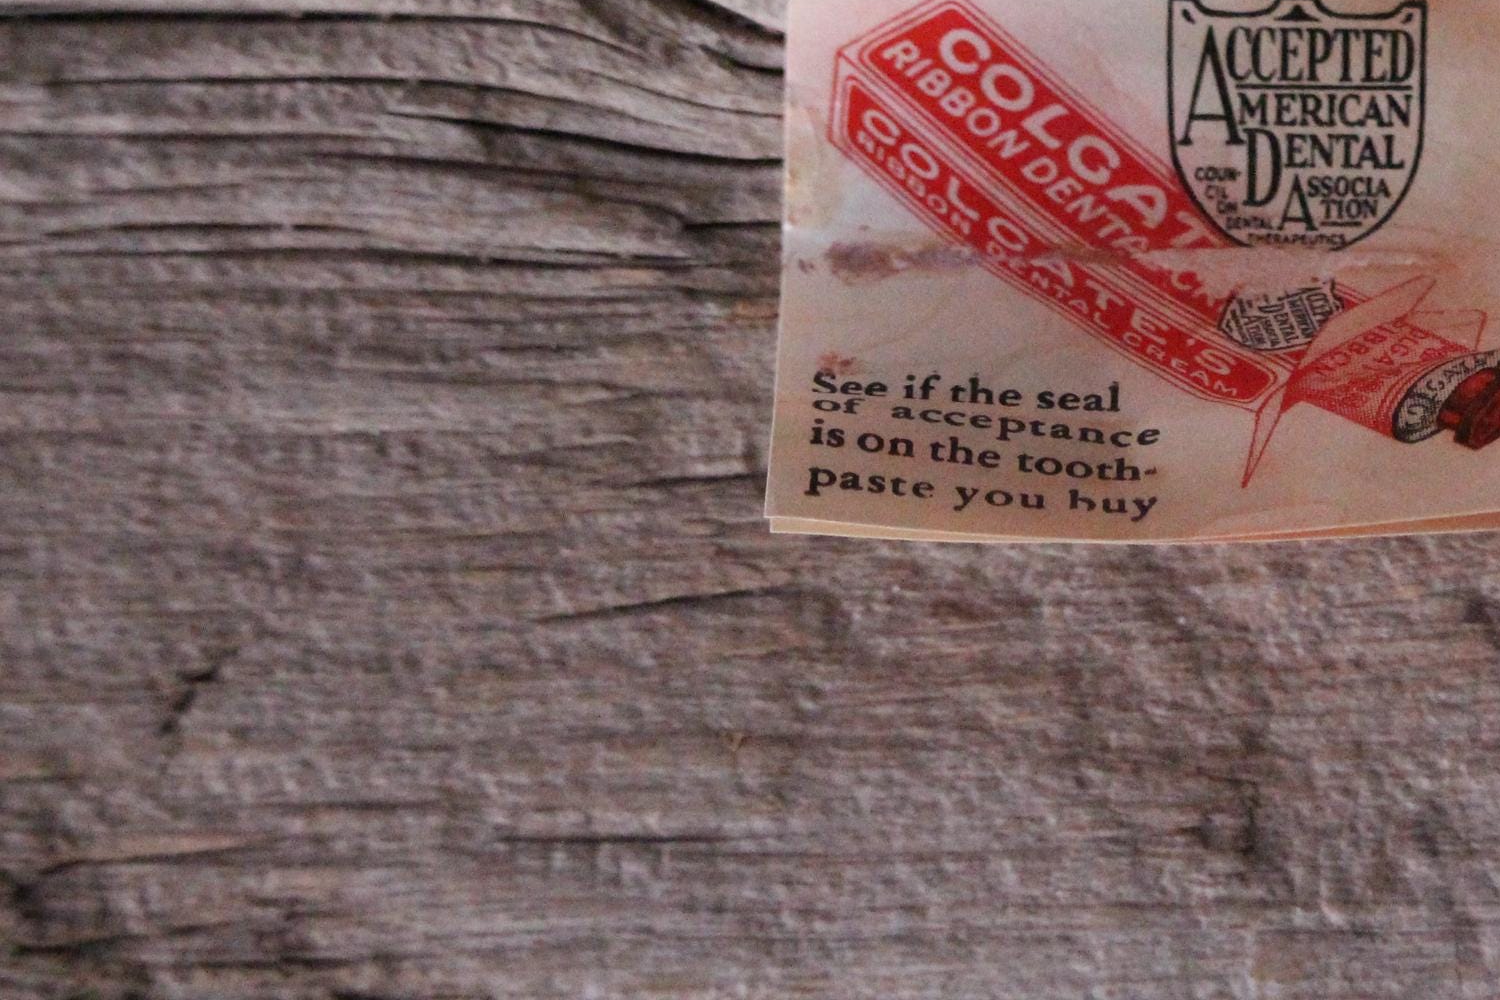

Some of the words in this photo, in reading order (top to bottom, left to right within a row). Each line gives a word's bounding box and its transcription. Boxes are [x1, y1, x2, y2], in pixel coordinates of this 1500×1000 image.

[882, 40, 1030, 159] RIBBON
[1243, 128, 1405, 206] DENTAL
[1122, 331, 1237, 396] CREAM
[812, 369, 888, 398] See
[903, 374, 941, 400] if
[949, 374, 1022, 408] the
[1036, 381, 1121, 412] seal
[809, 418, 845, 449] is
[857, 431, 915, 459] on
[929, 436, 1001, 469] the
[811, 398, 867, 415] of
[891, 404, 1161, 449] acceptance
[803, 466, 934, 498] paste
[953, 485, 1046, 513] you
